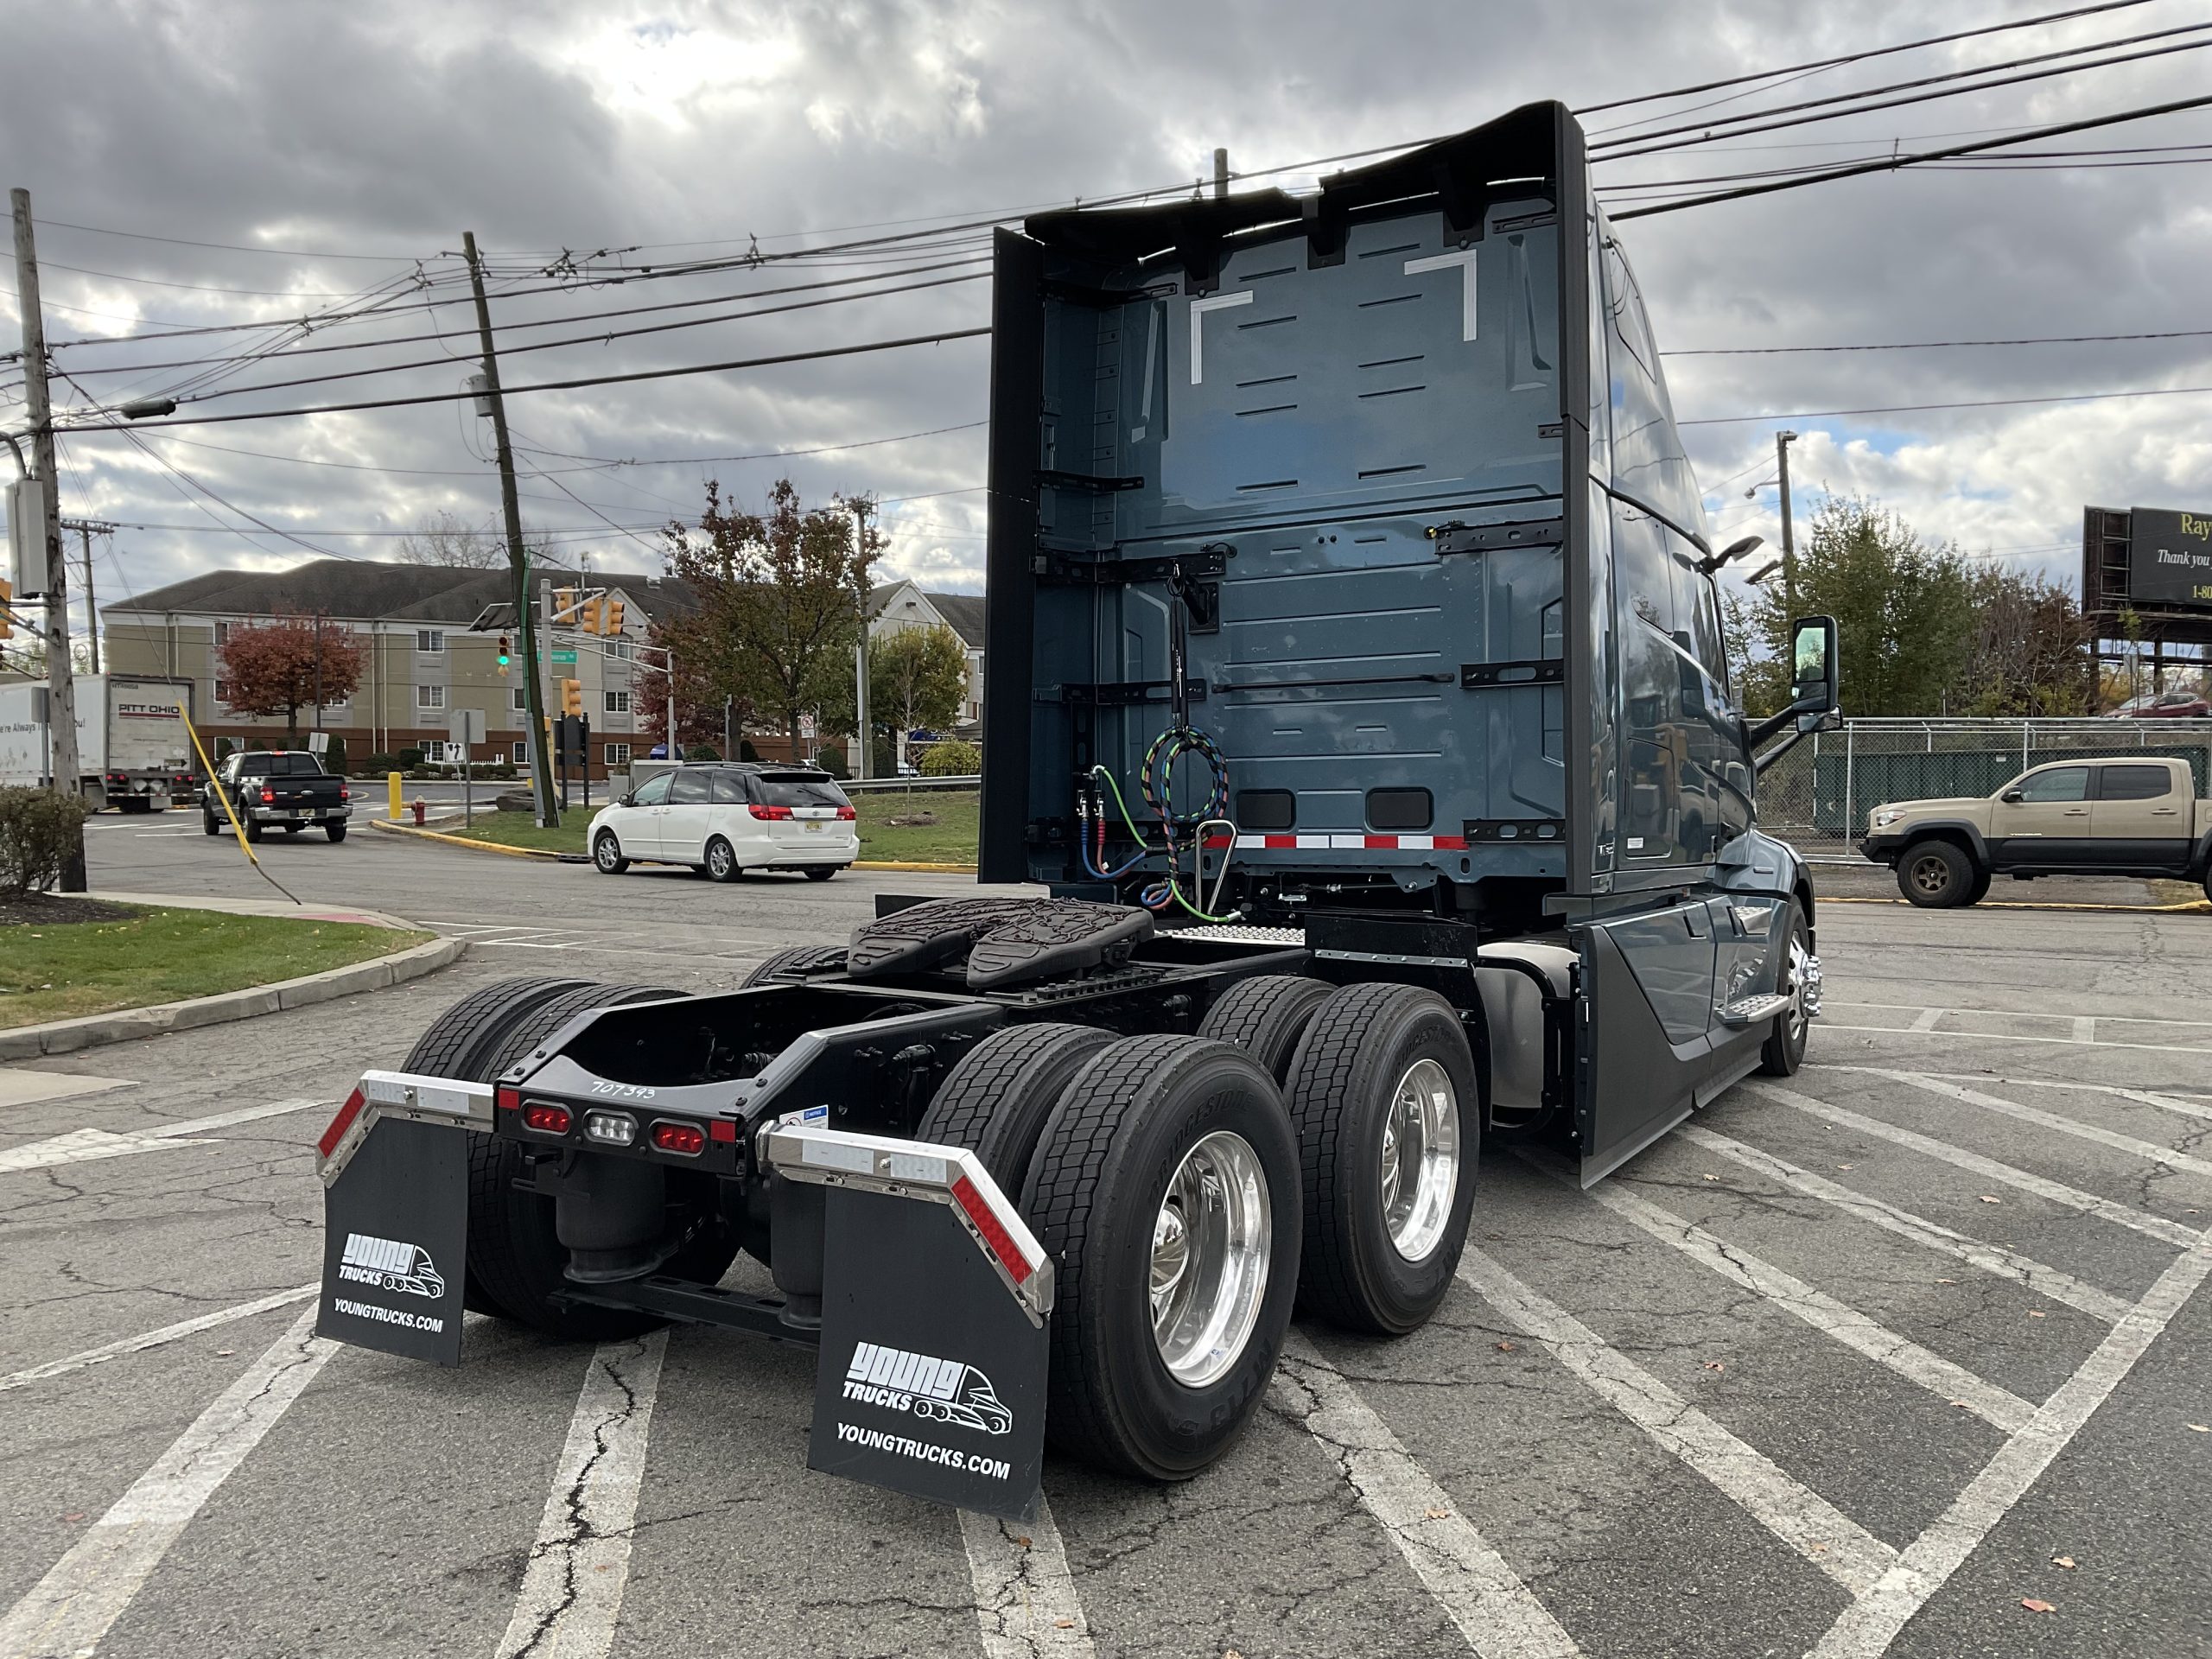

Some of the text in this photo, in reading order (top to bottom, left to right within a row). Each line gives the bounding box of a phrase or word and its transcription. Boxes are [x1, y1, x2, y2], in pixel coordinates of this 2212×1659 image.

[2181, 513, 2212, 541] Ray
[2158, 549, 2210, 569] Thank you
[149, 705, 180, 714] OHIO
[13, 722, 35, 734] Always
[74, 717, 86, 728] ou!
[591, 1081, 656, 1099] 707393
[339, 1265, 383, 1286] TRUCKS
[334, 1298, 443, 1333] YOUNGTRUCKS.COM
[842, 1381, 913, 1412] TRUCKS
[837, 1422, 1011, 1480] YOUNGTRUCKS.COM
